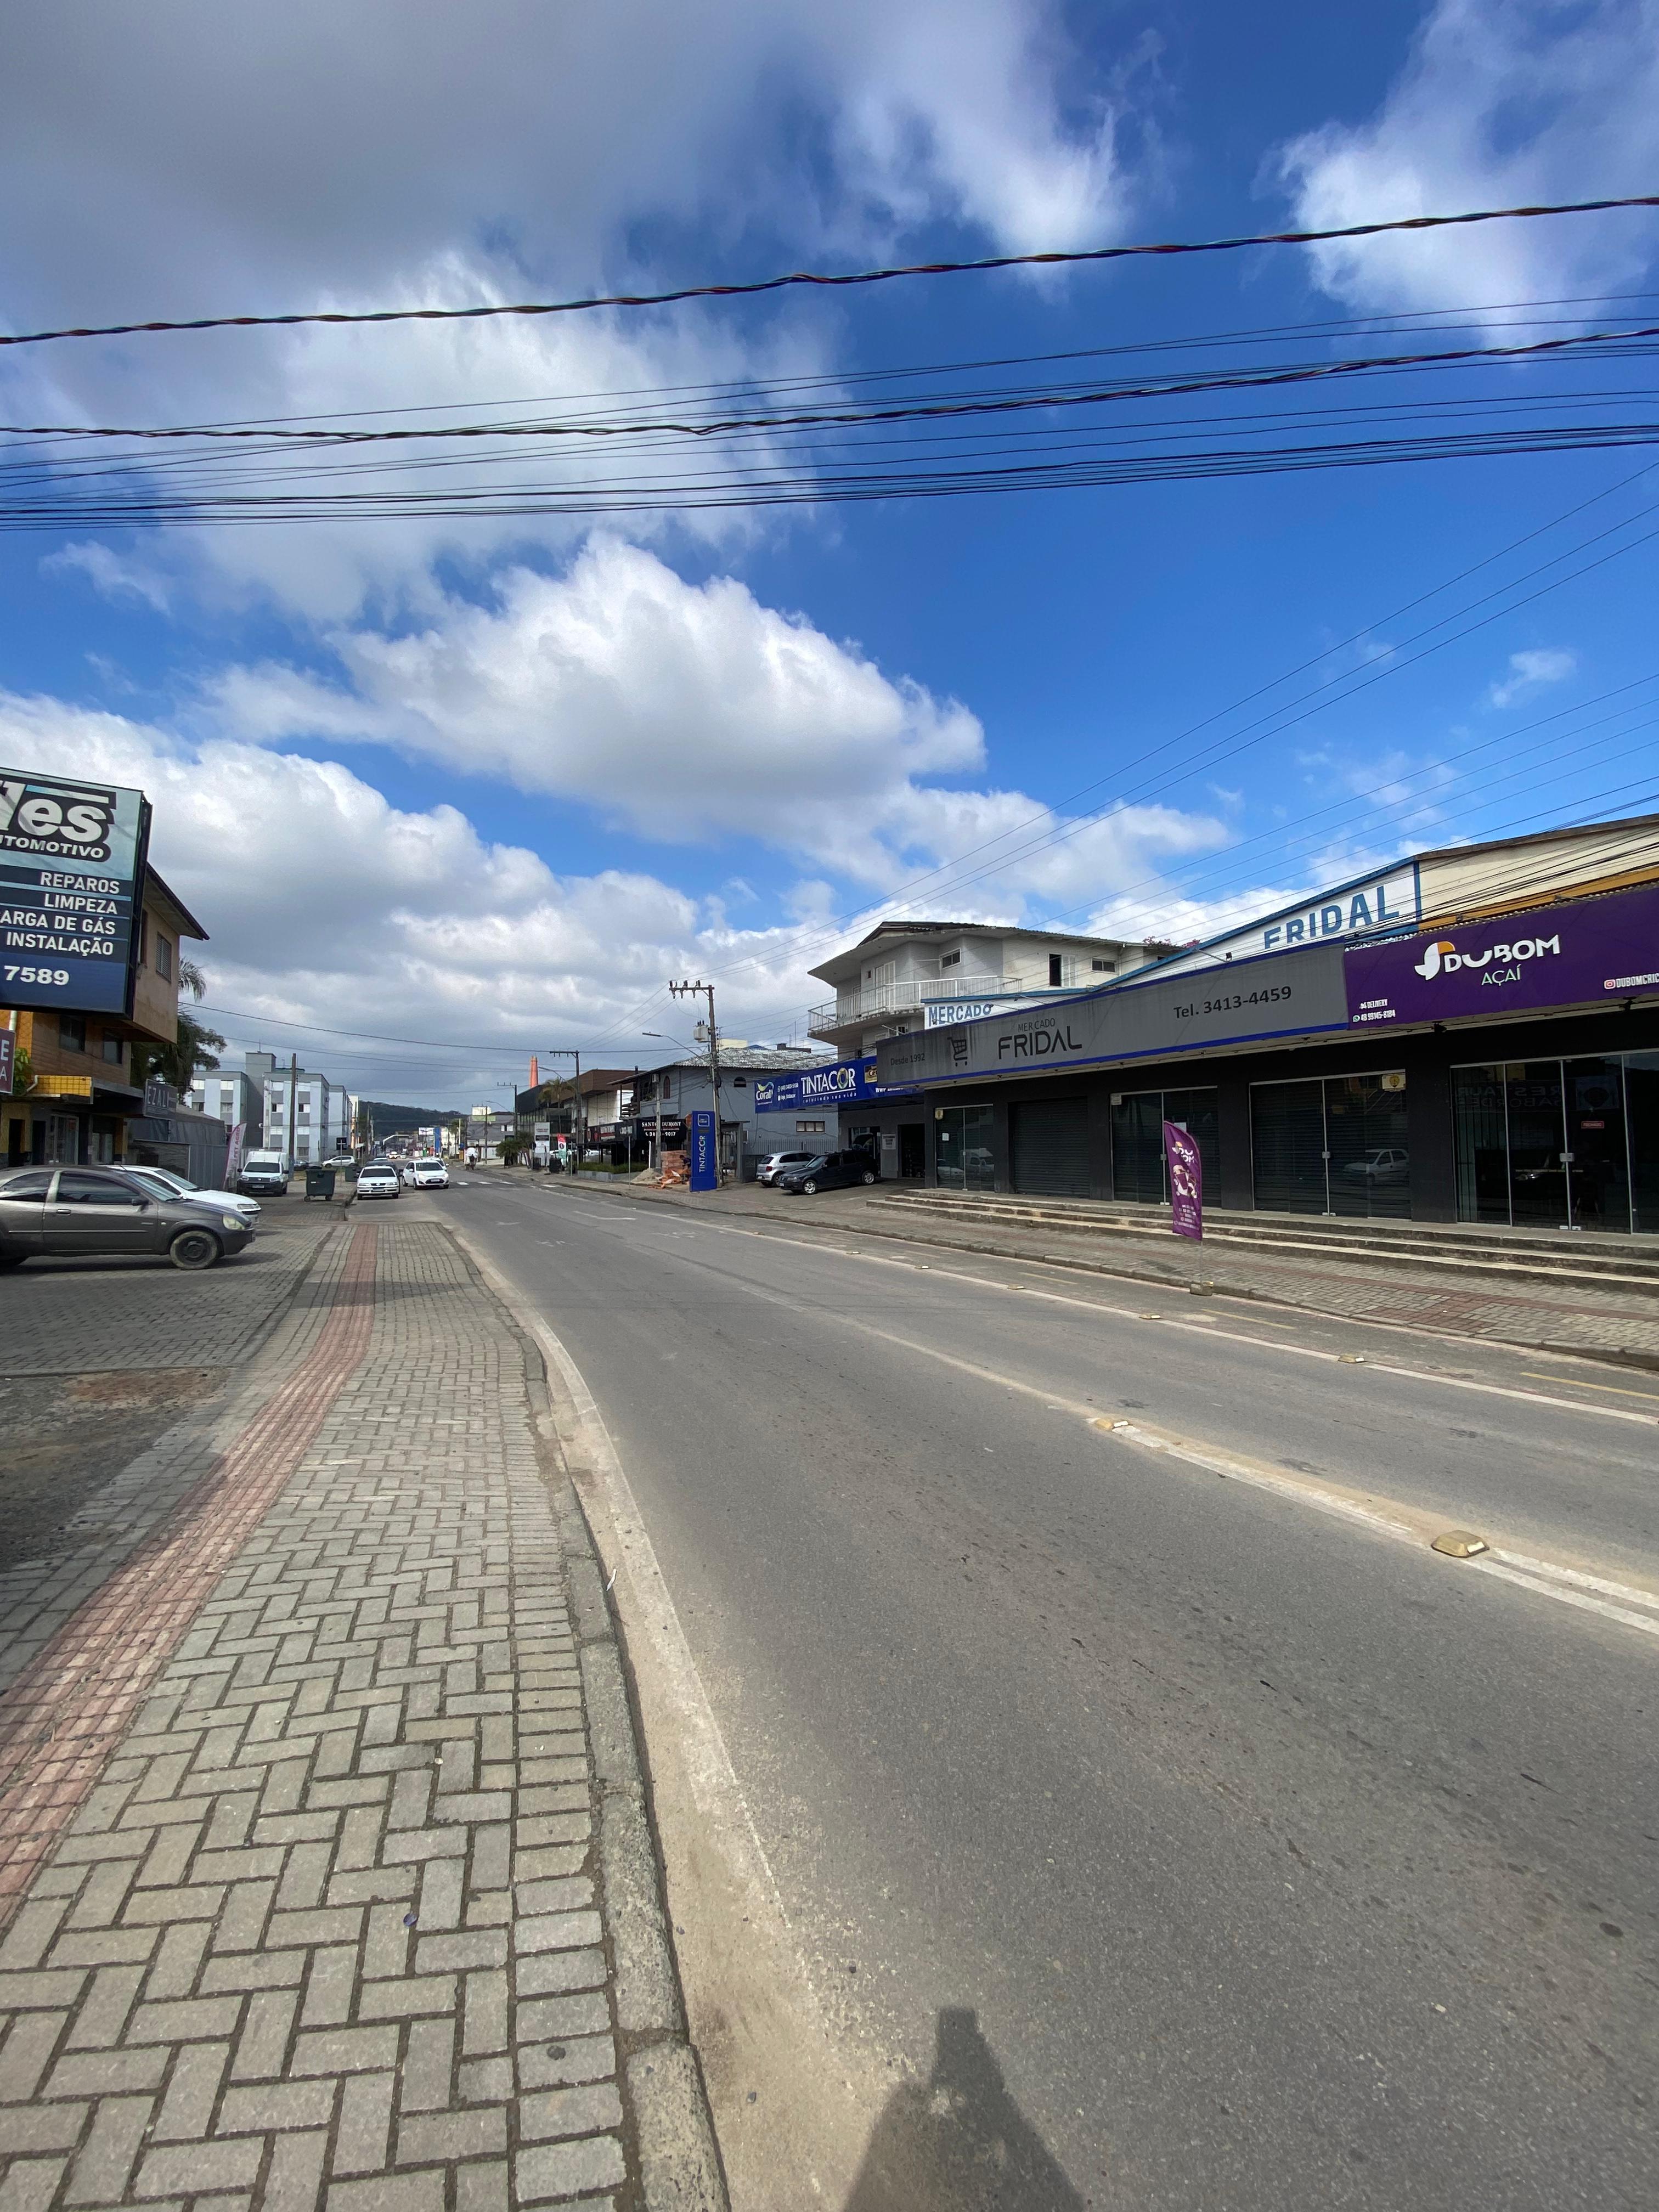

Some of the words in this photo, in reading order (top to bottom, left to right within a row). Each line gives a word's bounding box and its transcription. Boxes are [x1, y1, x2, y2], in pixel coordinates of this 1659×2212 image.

[0, 835, 104, 859] TOMOTIVO
[40, 872, 120, 894] REPAROS
[44, 893, 118, 915] LIMPEZA
[0, 910, 48, 928] ARGA
[54, 915, 77, 931] DE
[82, 917, 116, 935] GÁS
[1263, 885, 1399, 950] FRIDAL
[6, 932, 114, 957] INSTALAÇÃO
[1444, 934, 1561, 973] DUBOM
[4, 965, 70, 986] 7589
[1481, 963, 1521, 986] AÇAÍ
[1173, 1003, 1199, 1019] Tel.
[1204, 986, 1292, 1014] 3413-4459
[1367, 998, 1388, 1008] DELIVERY
[929, 1003, 992, 1027] MERCADO
[1018, 1018, 1056, 1032] MERCADO
[998, 1025, 1082, 1060] FRIDAL
[890, 1056, 909, 1065] Desde
[910, 1053, 926, 1063] 1992
[800, 1067, 856, 1095] TINTACOR
[756, 1089, 772, 1101] Coral
